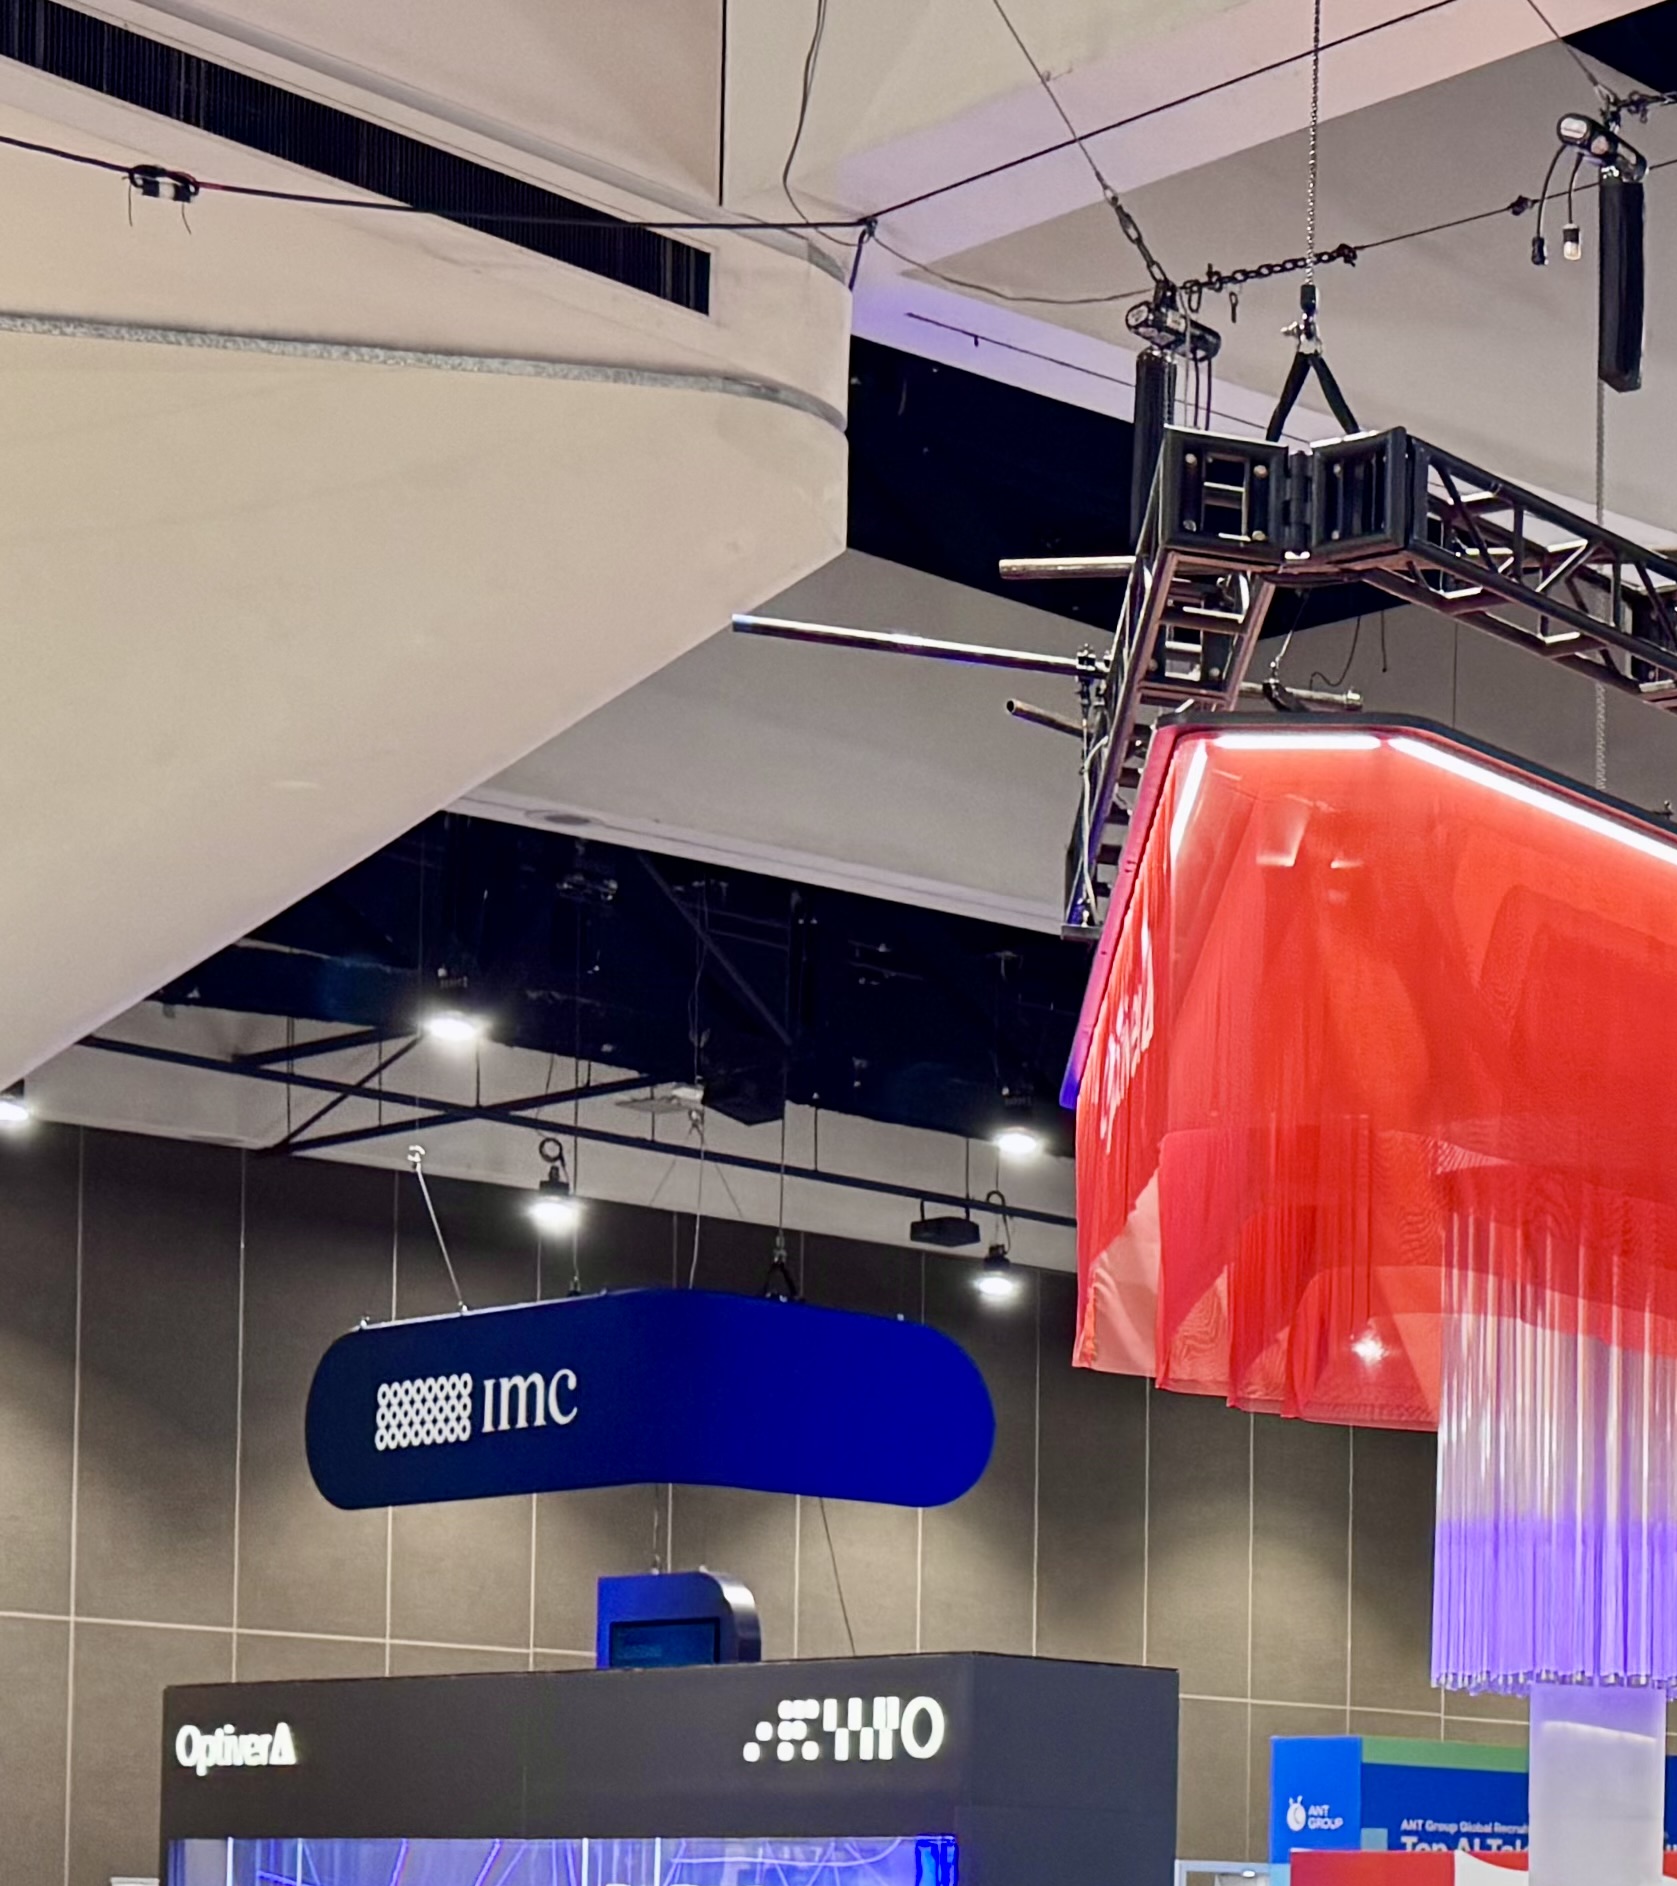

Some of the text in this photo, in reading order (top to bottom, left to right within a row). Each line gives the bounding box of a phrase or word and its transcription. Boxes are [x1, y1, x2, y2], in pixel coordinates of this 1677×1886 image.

[175, 1723, 273, 1776] Optiver
[1308, 1804, 1329, 1818] ANT
[1307, 1817, 1344, 1830] GROUP
[1400, 1819, 1423, 1832] ANT
[1425, 1820, 1458, 1834] Group
